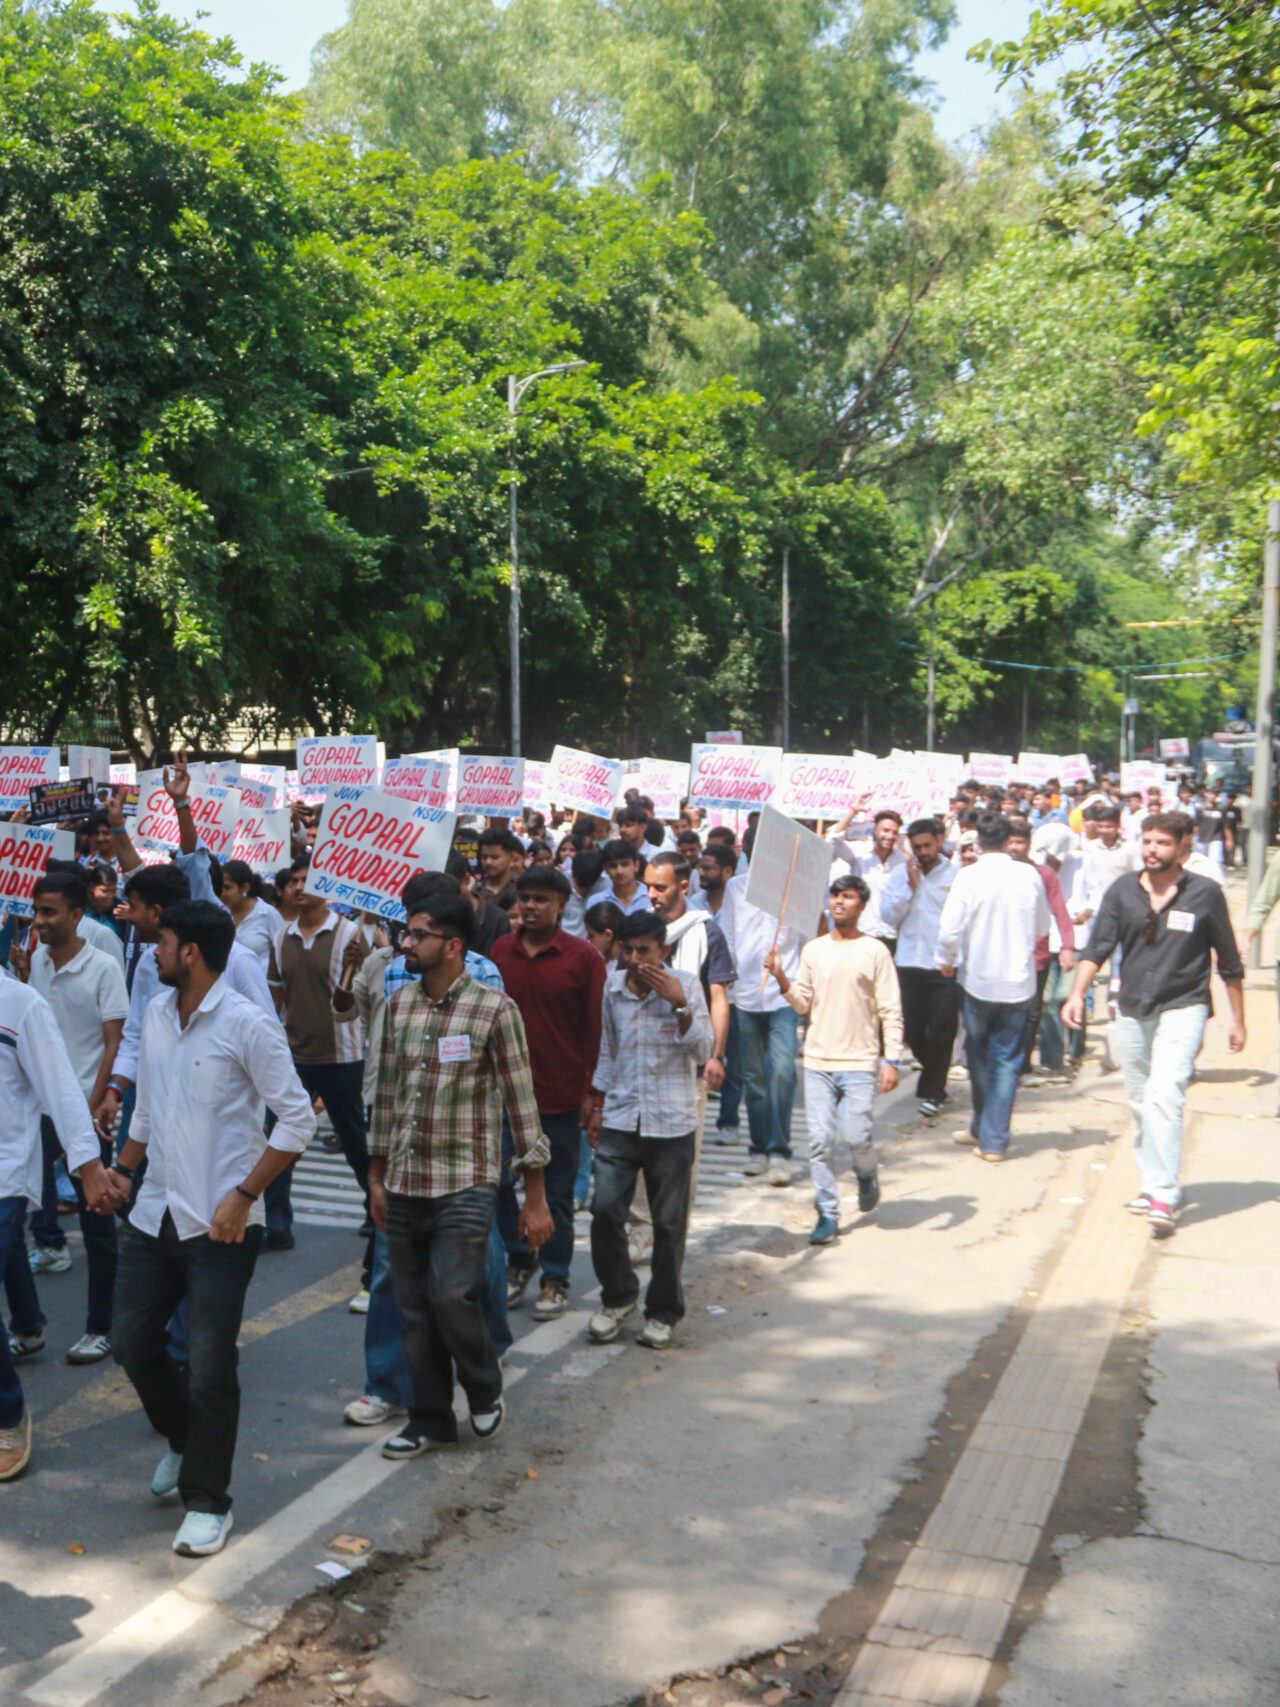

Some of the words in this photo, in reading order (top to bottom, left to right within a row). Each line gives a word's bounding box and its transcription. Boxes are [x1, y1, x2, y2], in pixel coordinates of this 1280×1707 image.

[303, 746, 364, 767] GOPAAL
[697, 754, 761, 778] GOPAAL
[301, 767, 376, 786] CHOUDHARY
[384, 767, 427, 788] GOPAAL
[463, 765, 514, 786] GOPAAL
[558, 758, 613, 787] GOPAAL
[789, 765, 856, 790] GOPAAL
[457, 785, 522, 807] CHOUDHARY
[548, 776, 616, 808] CHOUDHARY
[691, 777, 776, 803] CHOUDHARY
[334, 786, 363, 801] JOIN
[412, 805, 447, 823] NSUI
[25, 828, 56, 842] NSUI
[327, 803, 425, 859] GOPAAL
[314, 876, 337, 893] DU
[336, 883, 356, 900] का
[354, 890, 384, 911] लाल
